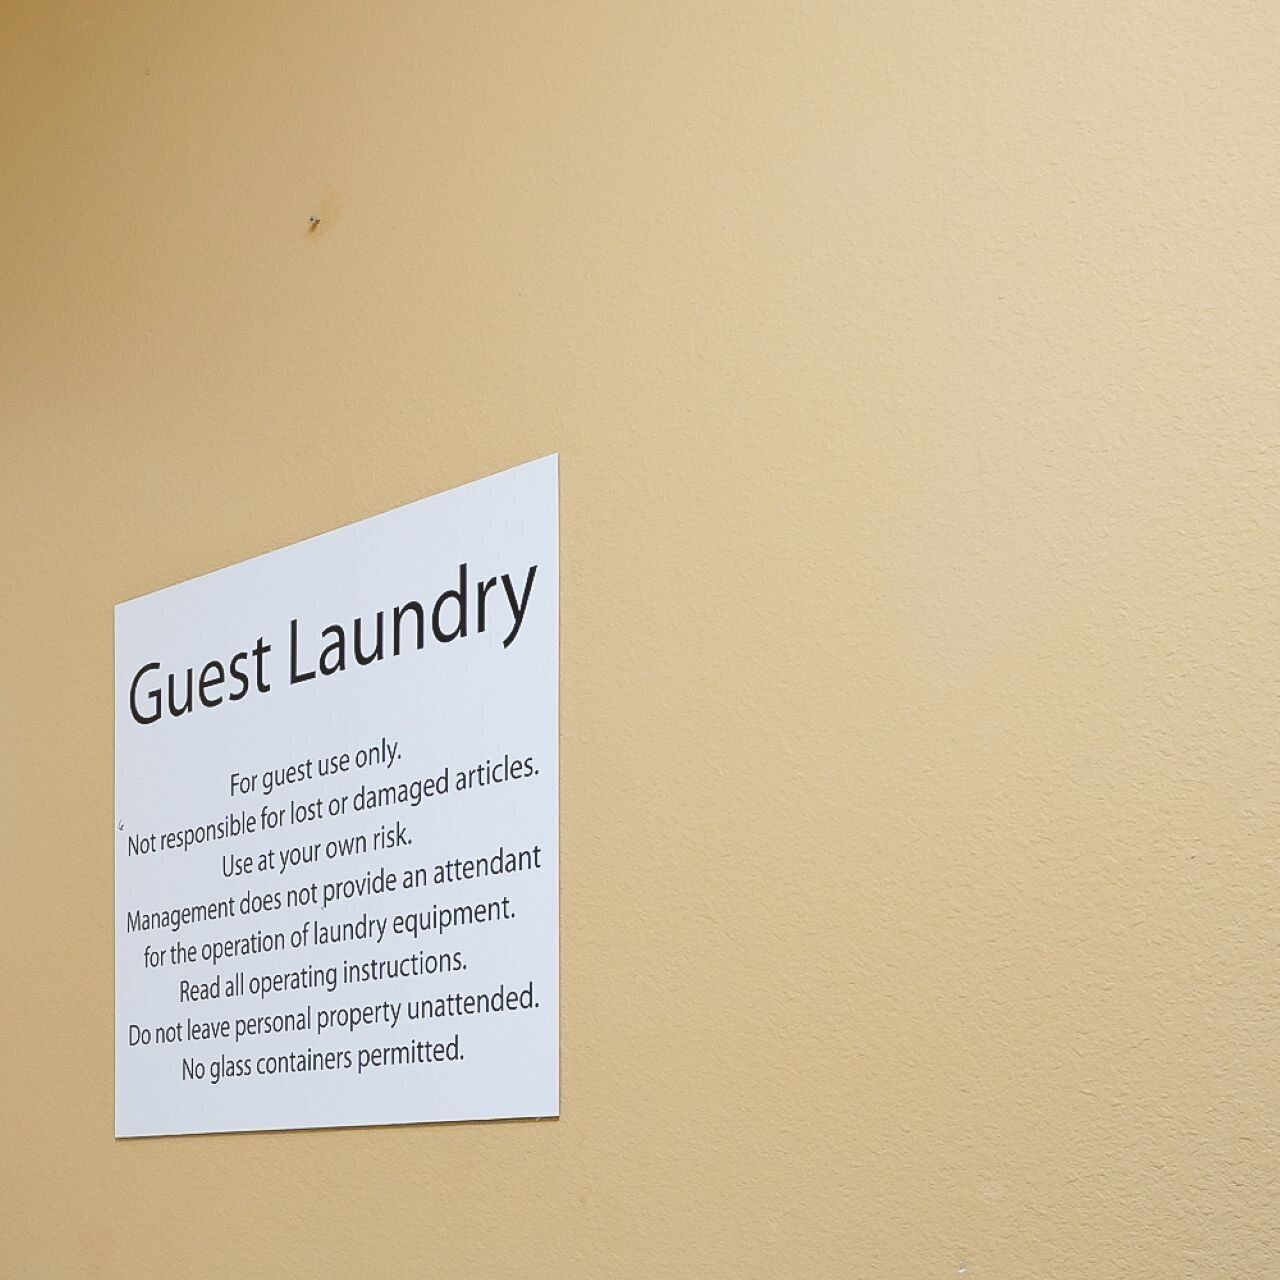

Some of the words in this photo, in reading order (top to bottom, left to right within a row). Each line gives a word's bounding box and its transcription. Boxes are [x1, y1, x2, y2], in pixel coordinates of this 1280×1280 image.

[129, 636, 272, 725] Guest
[289, 562, 538, 685] Laundry
[230, 772, 258, 797] For
[262, 758, 313, 796] guest
[318, 753, 350, 777] use
[355, 737, 402, 769] only.
[128, 833, 157, 857] Not
[160, 810, 257, 852] responsible
[260, 805, 286, 830] for
[290, 798, 323, 825] lost
[328, 795, 349, 816] or
[353, 767, 449, 812] damaged
[455, 754, 539, 792] articles.
[222, 854, 253, 878] Use
[257, 849, 275, 872] at
[279, 843, 322, 875] your
[325, 835, 367, 859] own
[373, 820, 413, 851] risk.
[127, 897, 236, 934] Management
[239, 889, 282, 915] does
[287, 883, 318, 908] not
[323, 867, 398, 909] provide
[402, 868, 427, 889] an
[433, 845, 542, 884] attendant
[143, 945, 167, 969] for
[169, 941, 198, 965] the
[201, 930, 285, 966] operation
[290, 921, 310, 948] of
[314, 913, 388, 945] laundry
[392, 896, 515, 939] equipment.
[180, 974, 221, 1003] Read
[225, 971, 244, 998] all
[248, 964, 337, 1000] operating
[343, 950, 467, 984] instructions.
[129, 1024, 152, 1047] Do
[155, 1022, 183, 1044] not
[187, 1017, 231, 1041] leave
[235, 1005, 311, 1043] personal
[317, 1001, 402, 1035] property
[407, 981, 540, 1020] unattended.
[182, 1057, 206, 1081] No
[210, 1053, 252, 1085] glass
[256, 1047, 353, 1075] containers
[357, 1034, 464, 1075] permitted.
